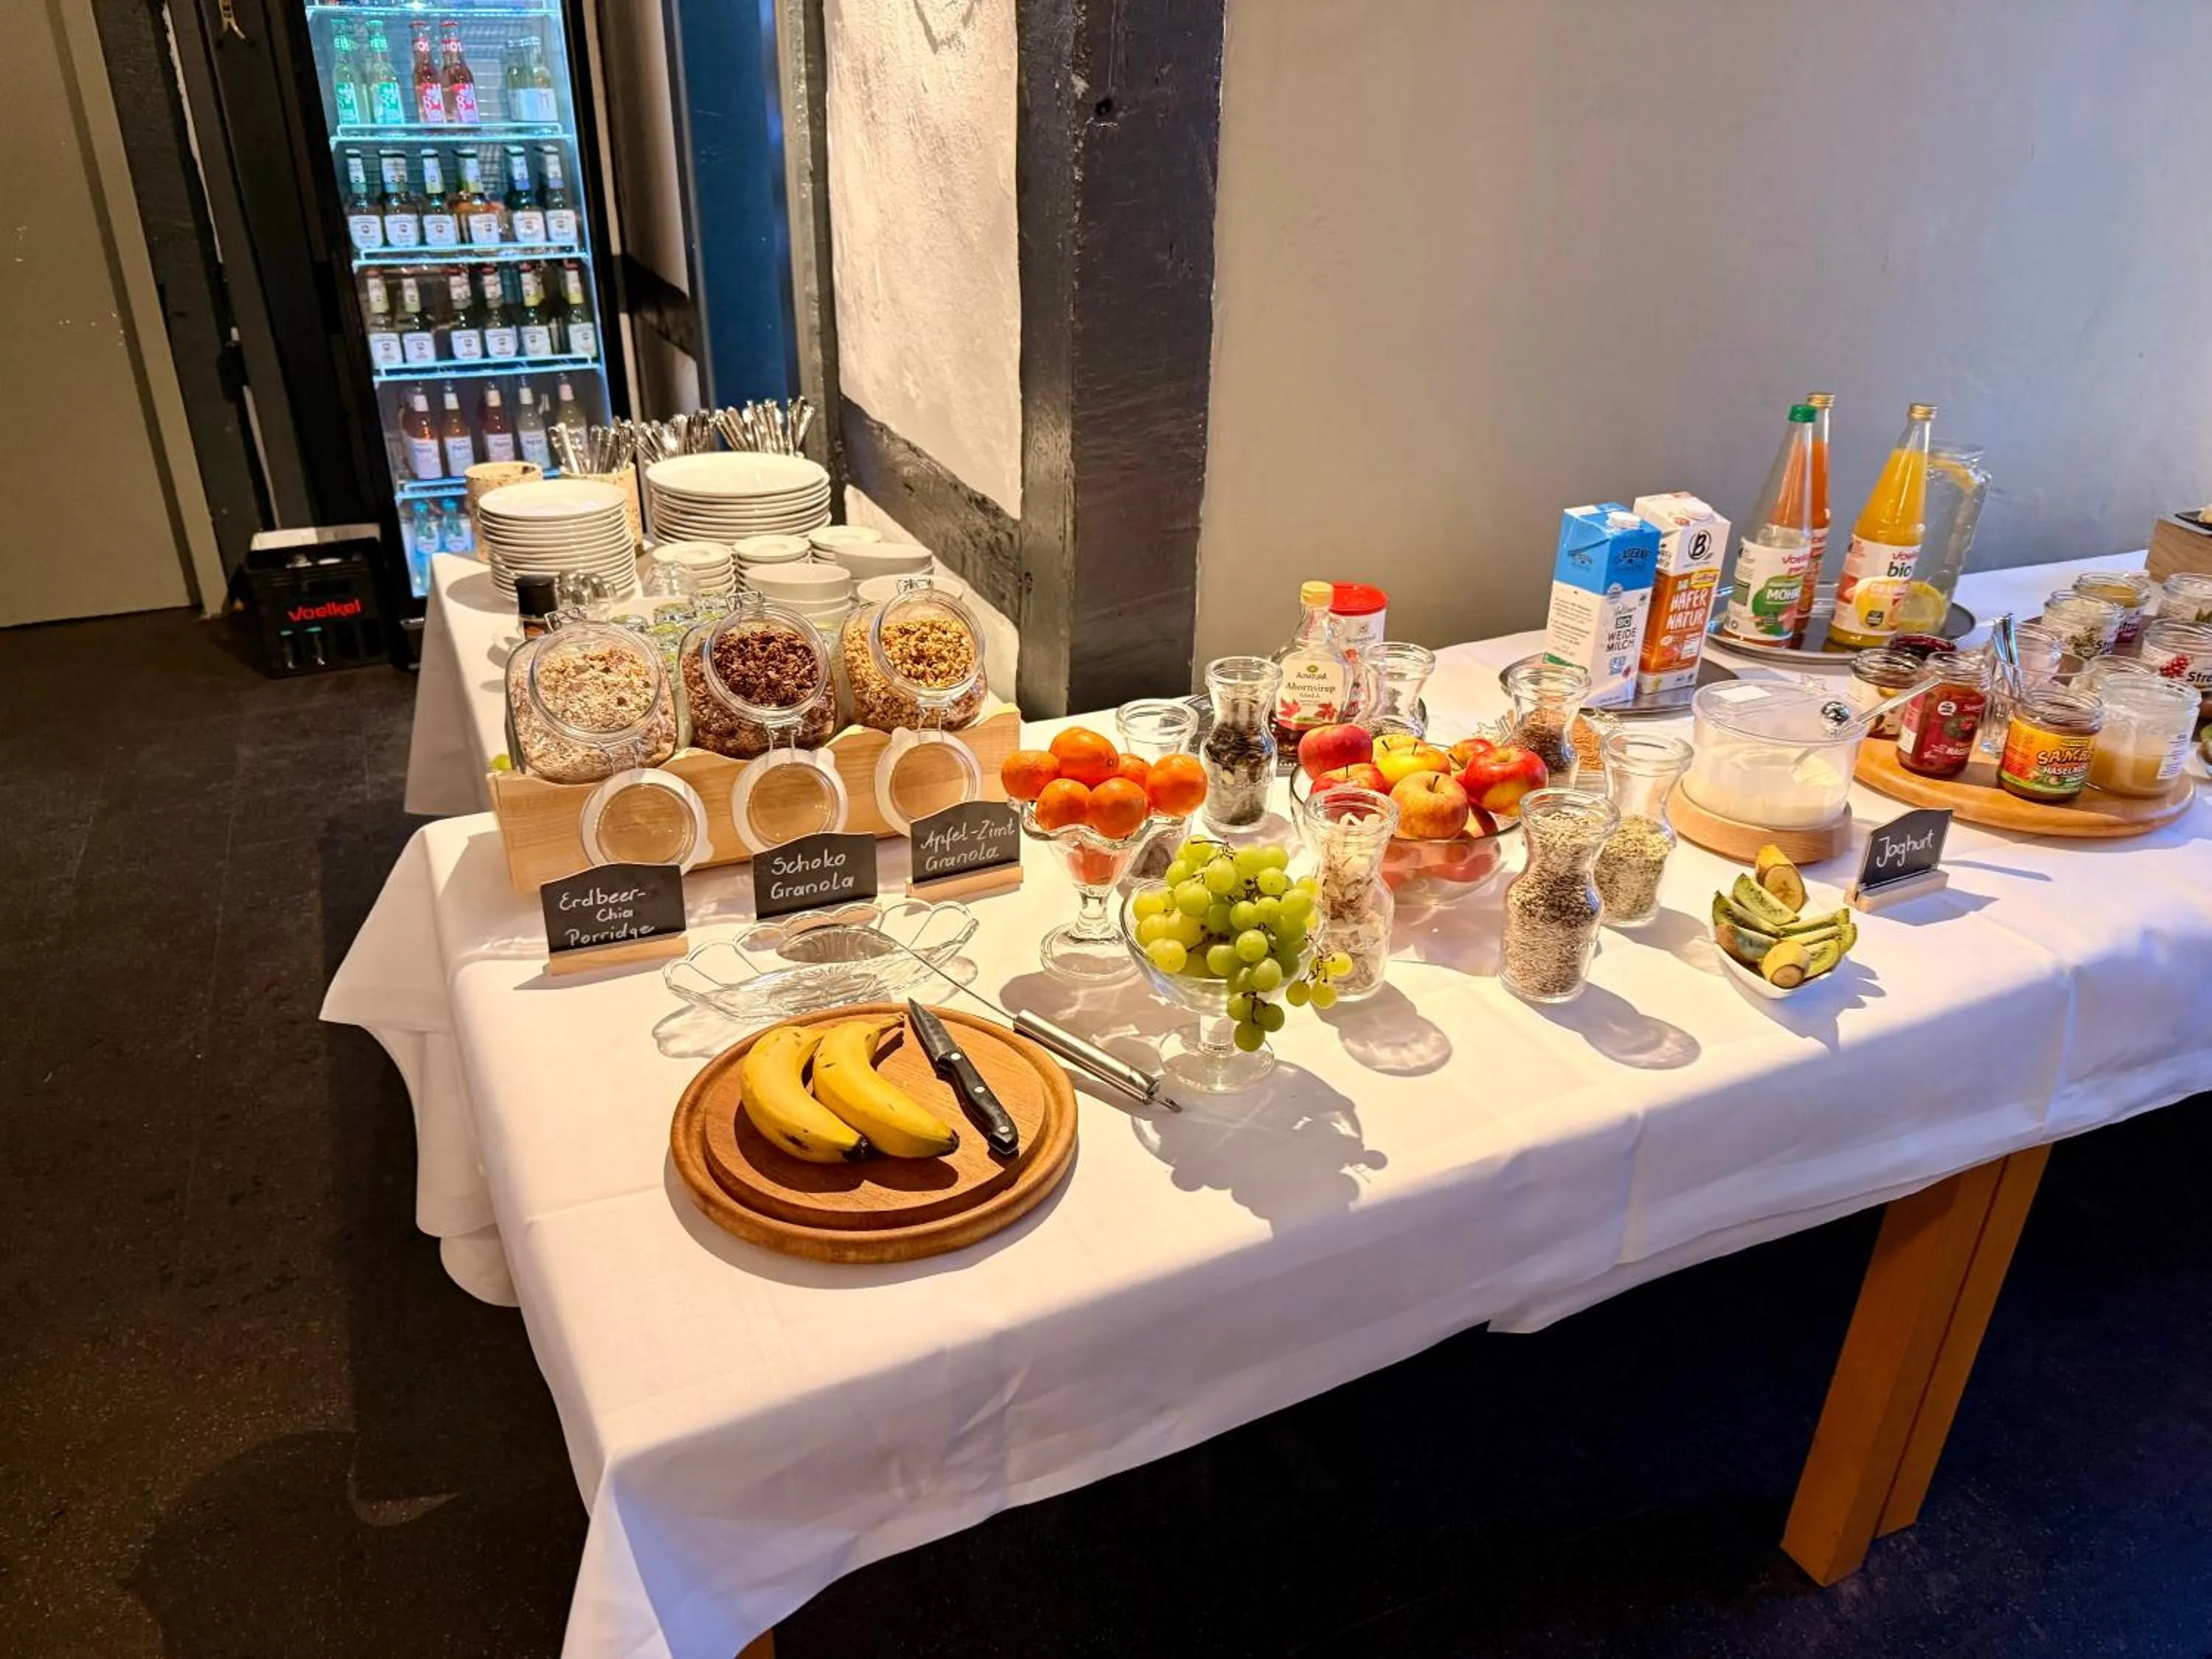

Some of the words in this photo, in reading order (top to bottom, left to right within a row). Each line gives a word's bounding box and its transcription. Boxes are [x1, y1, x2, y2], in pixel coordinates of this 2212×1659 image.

[287, 598, 363, 622] Voelkel
[1670, 588, 1708, 611] HAFER
[1666, 608, 1705, 630] NATUR
[1606, 639, 1635, 653] MILCH
[1607, 627, 1637, 642] WEIDE
[925, 843, 1000, 872] Granola
[1876, 828, 1935, 868] Joghurt
[771, 849, 846, 875] Schoko
[771, 872, 855, 900] Granola
[560, 887, 647, 911] Erdbeer-
[596, 907, 634, 922] Chia
[563, 922, 655, 947] Porridge
